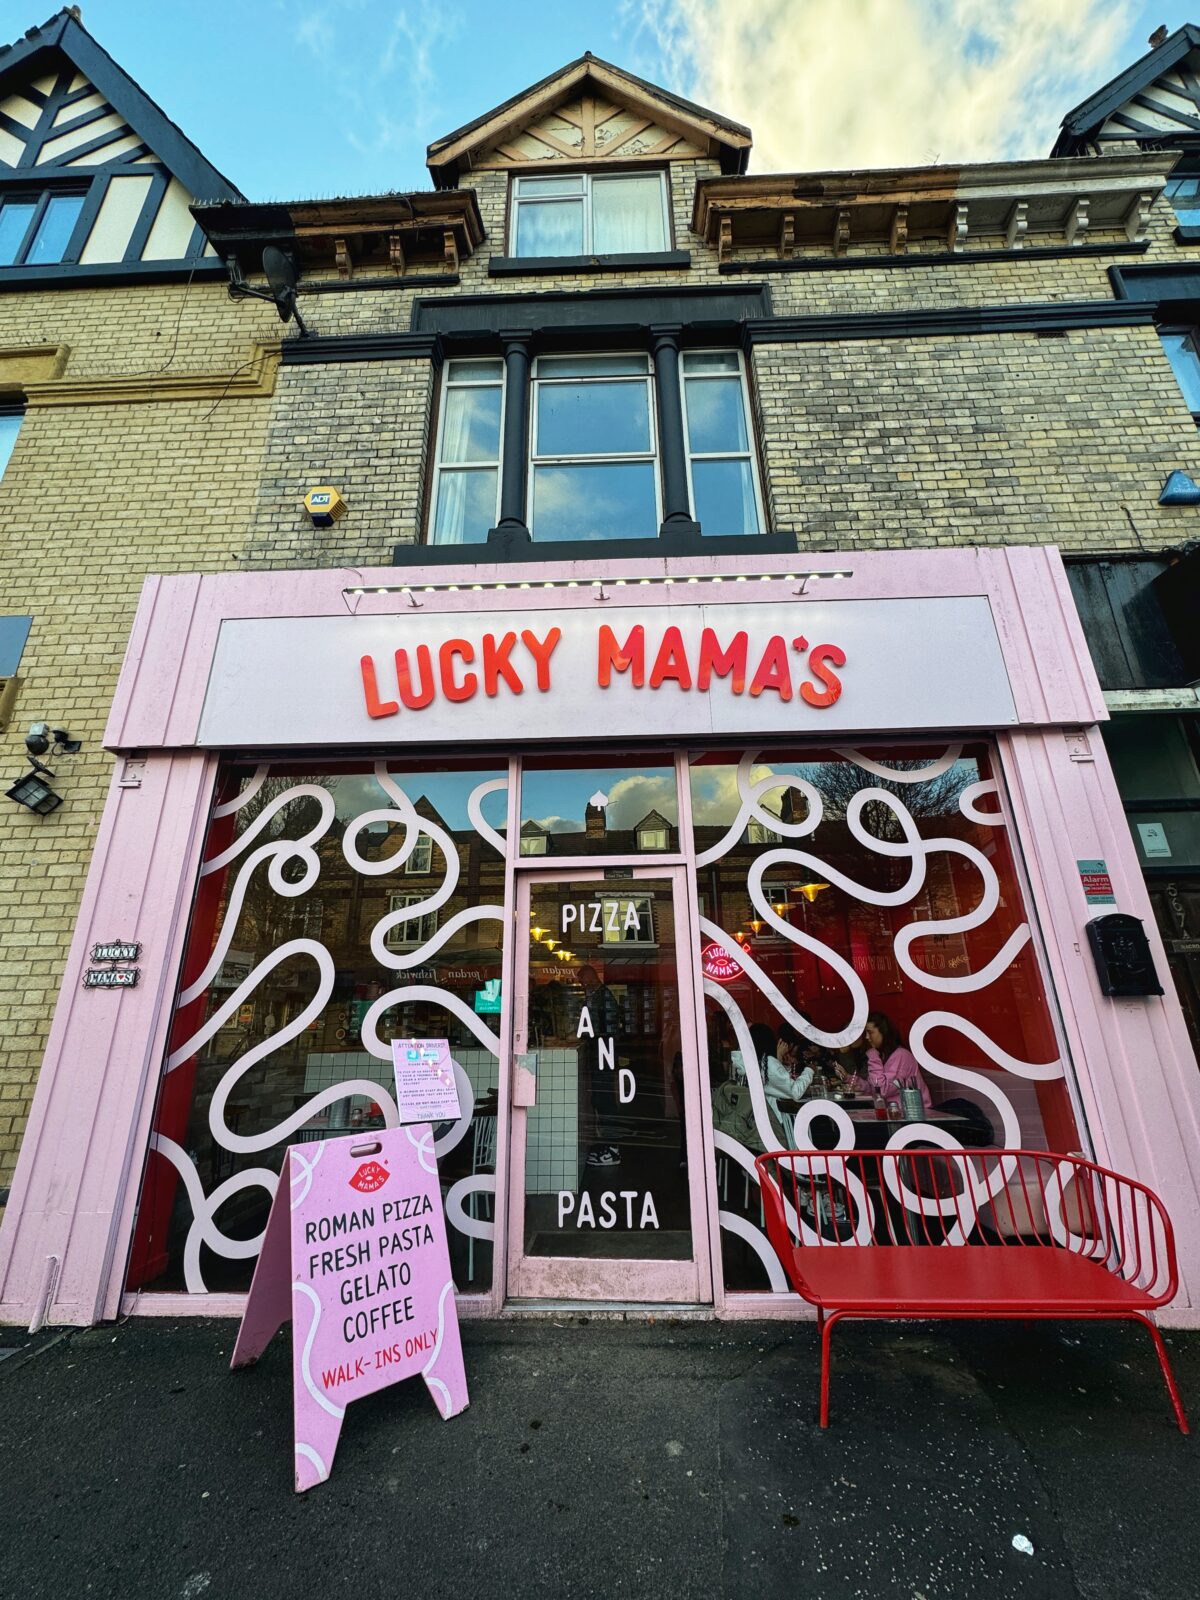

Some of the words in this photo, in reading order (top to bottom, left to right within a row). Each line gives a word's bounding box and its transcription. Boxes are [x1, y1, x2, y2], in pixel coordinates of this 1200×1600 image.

[311, 495, 329, 503] ADT
[361, 627, 561, 719] LUCKY
[562, 901, 641, 933] PIZZA
[97, 947, 135, 958] LUCKY
[705, 961, 739, 976] MAMA'S
[357, 1175, 385, 1190] MAMA'S
[358, 1166, 381, 1178] LUCKY
[305, 1207, 375, 1244] ROMAN
[382, 1194, 434, 1223] PIZZA
[558, 1190, 660, 1230] PASTA
[309, 1240, 371, 1279] FRESH
[379, 1224, 434, 1258] PASTA
[340, 1262, 412, 1306] GELATO
[343, 1296, 415, 1343] COFFEE
[405, 1327, 438, 1359] ONLY
